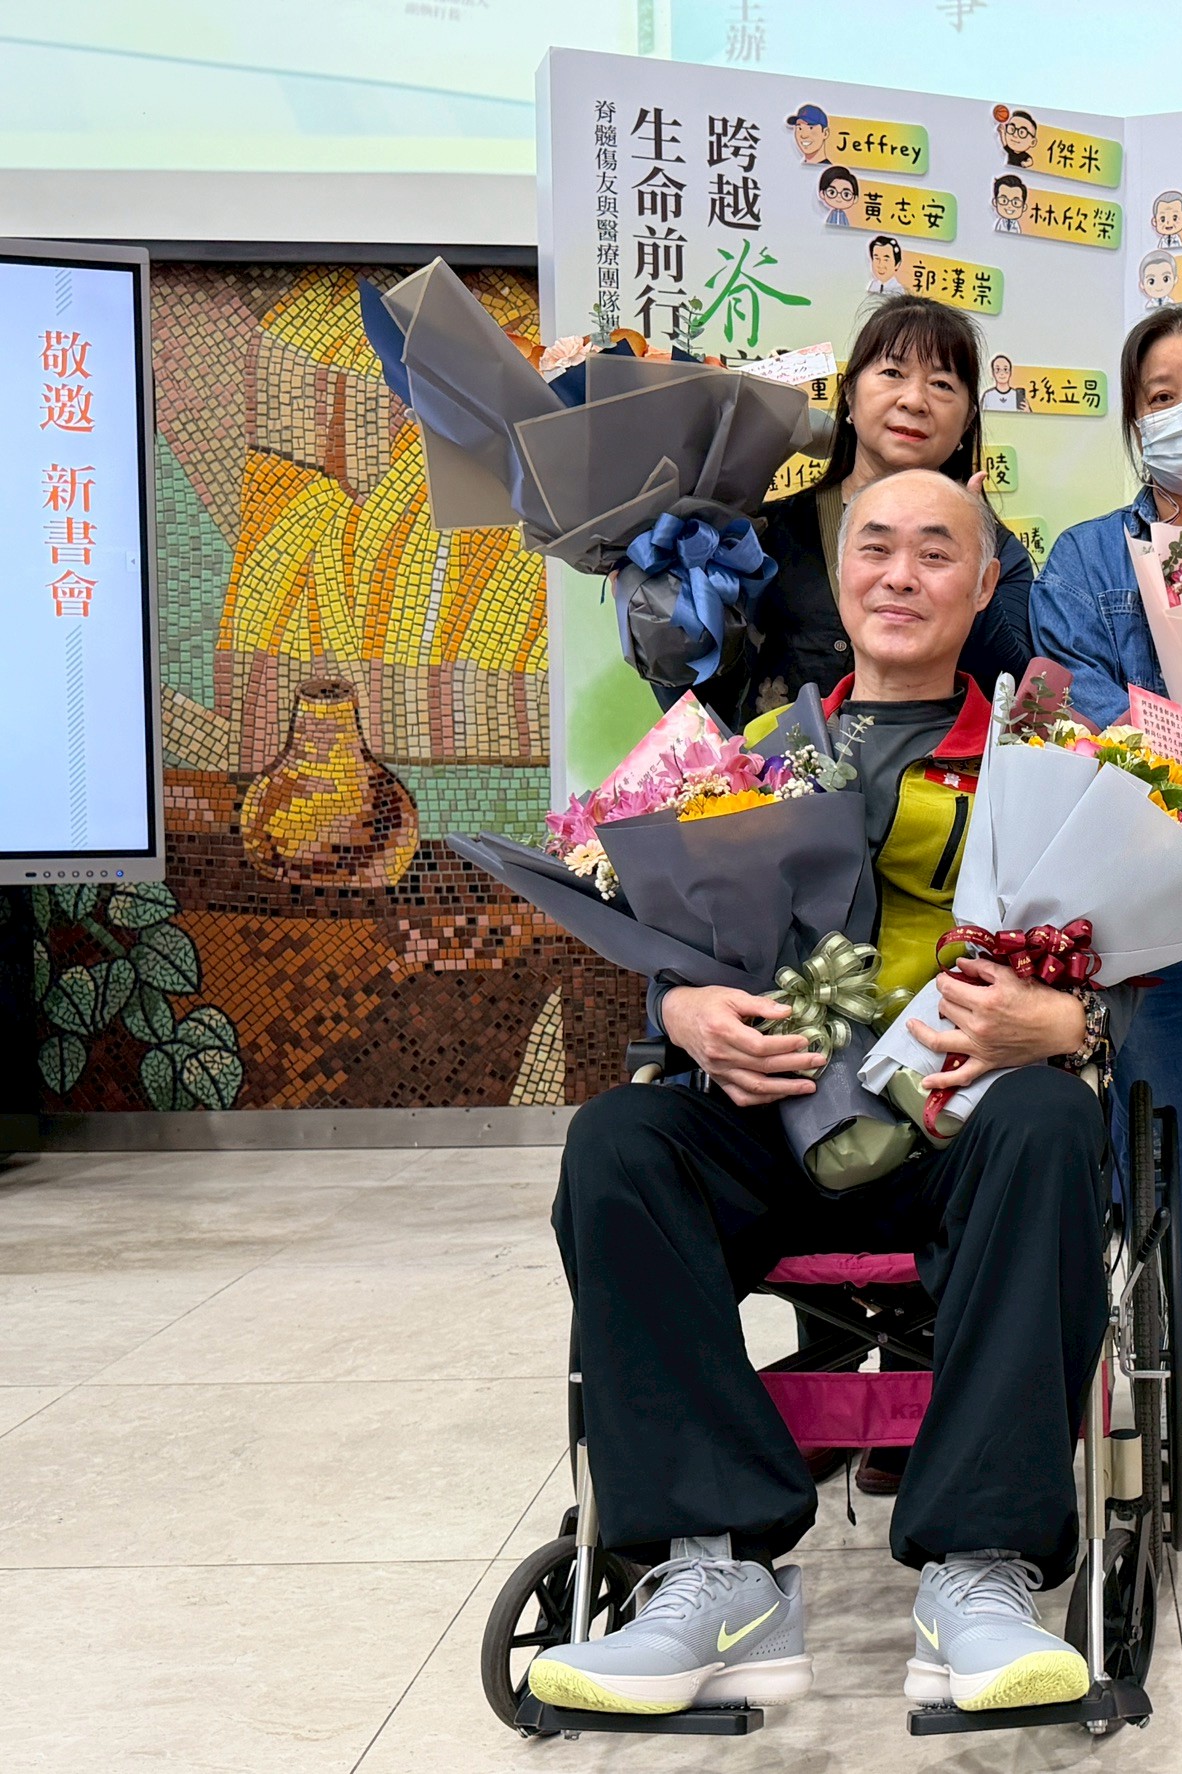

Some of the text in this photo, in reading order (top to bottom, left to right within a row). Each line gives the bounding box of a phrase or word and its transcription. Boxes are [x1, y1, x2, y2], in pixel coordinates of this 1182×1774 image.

[836, 131, 922, 167] Jeffrey
[1047, 139, 1101, 174] 傑米
[630, 107, 689, 340] 生命前行
[863, 191, 946, 230] 黃志安
[1029, 202, 1117, 241] 林欣榮
[912, 260, 993, 306] 郭漢崇
[1028, 376, 1101, 409] 孫立易
[38, 330, 99, 618] 敬邀 新書會
